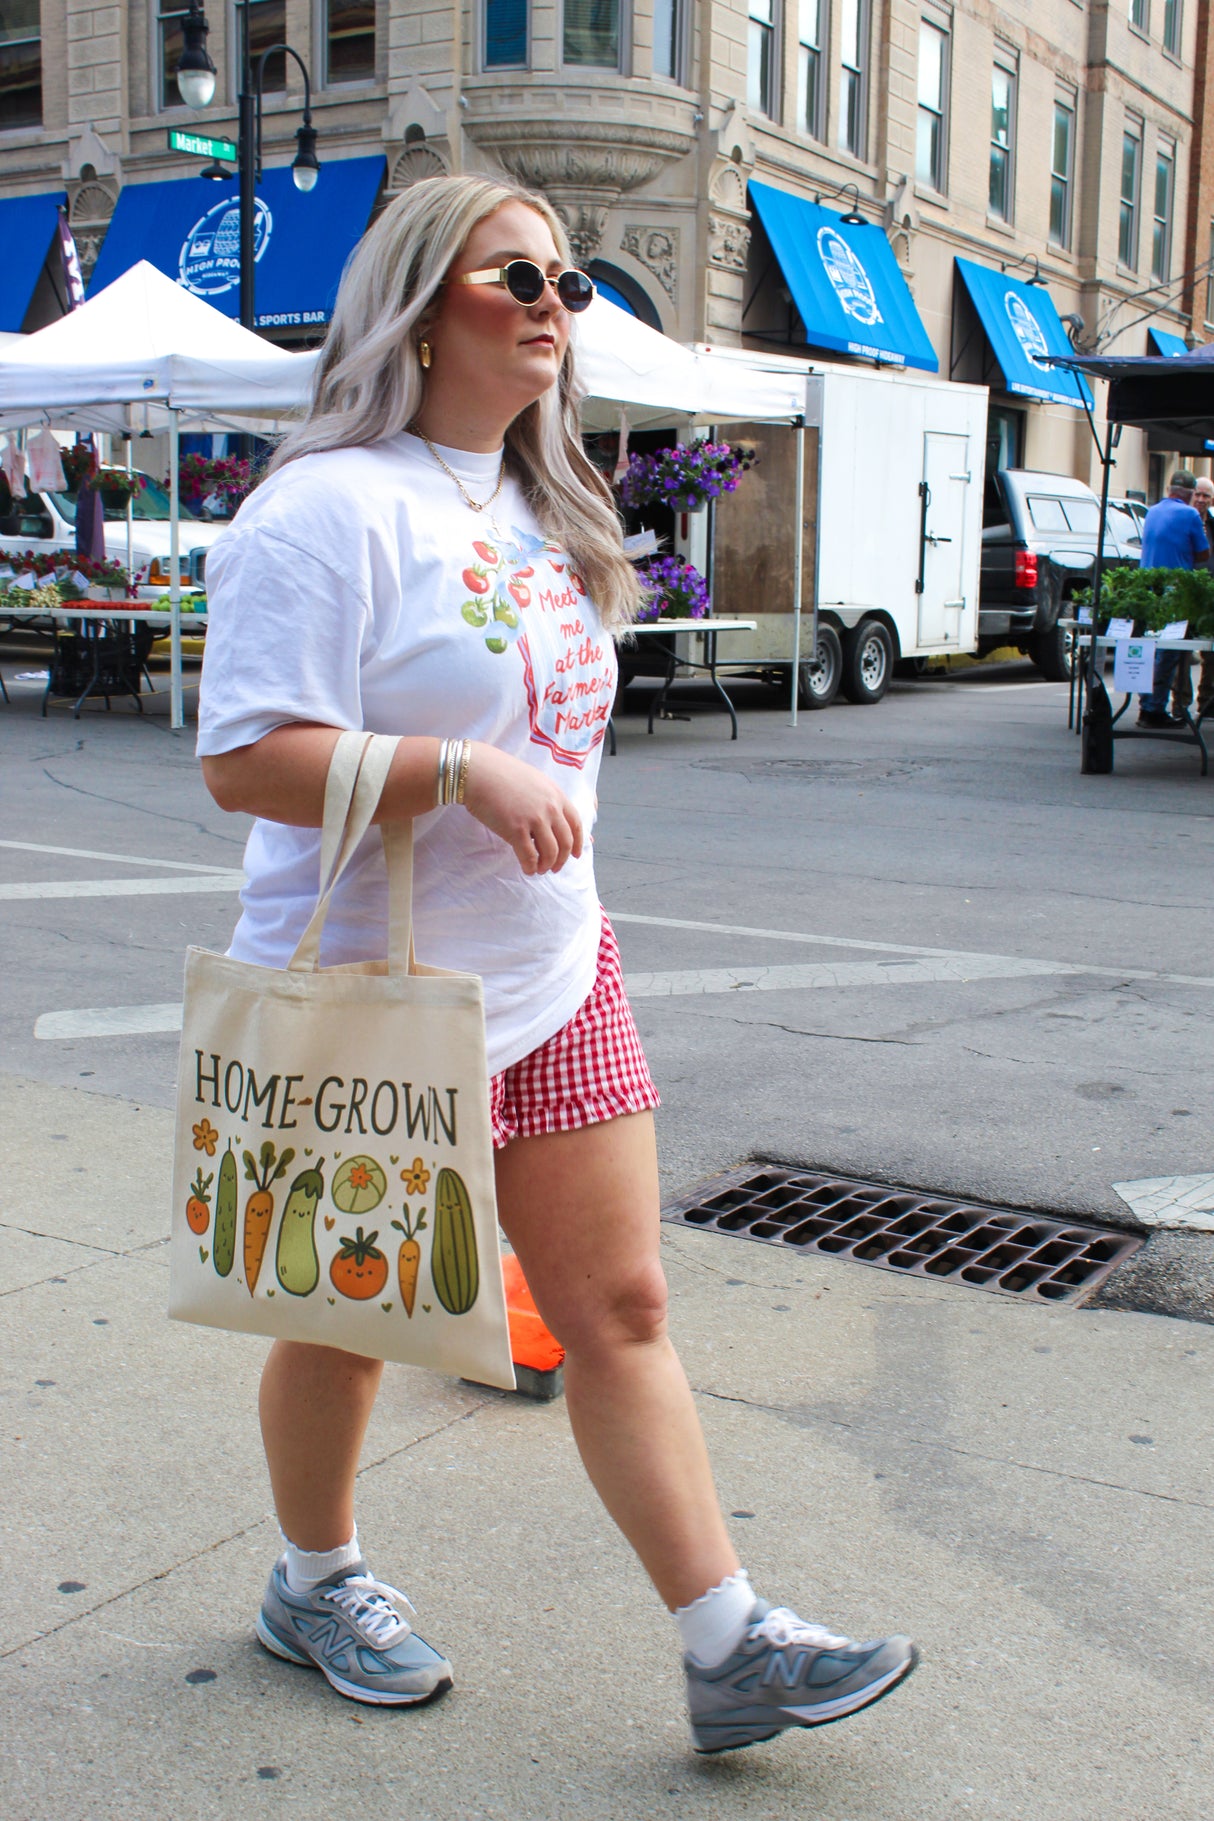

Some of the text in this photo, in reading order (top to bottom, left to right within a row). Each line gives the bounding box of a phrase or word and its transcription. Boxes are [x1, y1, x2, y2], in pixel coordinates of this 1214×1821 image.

[176, 132, 213, 156] Market
[186, 257, 241, 275] HIGH PRO
[259, 313, 301, 326] SPORTS
[303, 311, 325, 323] BAR
[538, 586, 578, 612] Meet
[560, 619, 585, 640] me
[555, 636, 603, 673] at the
